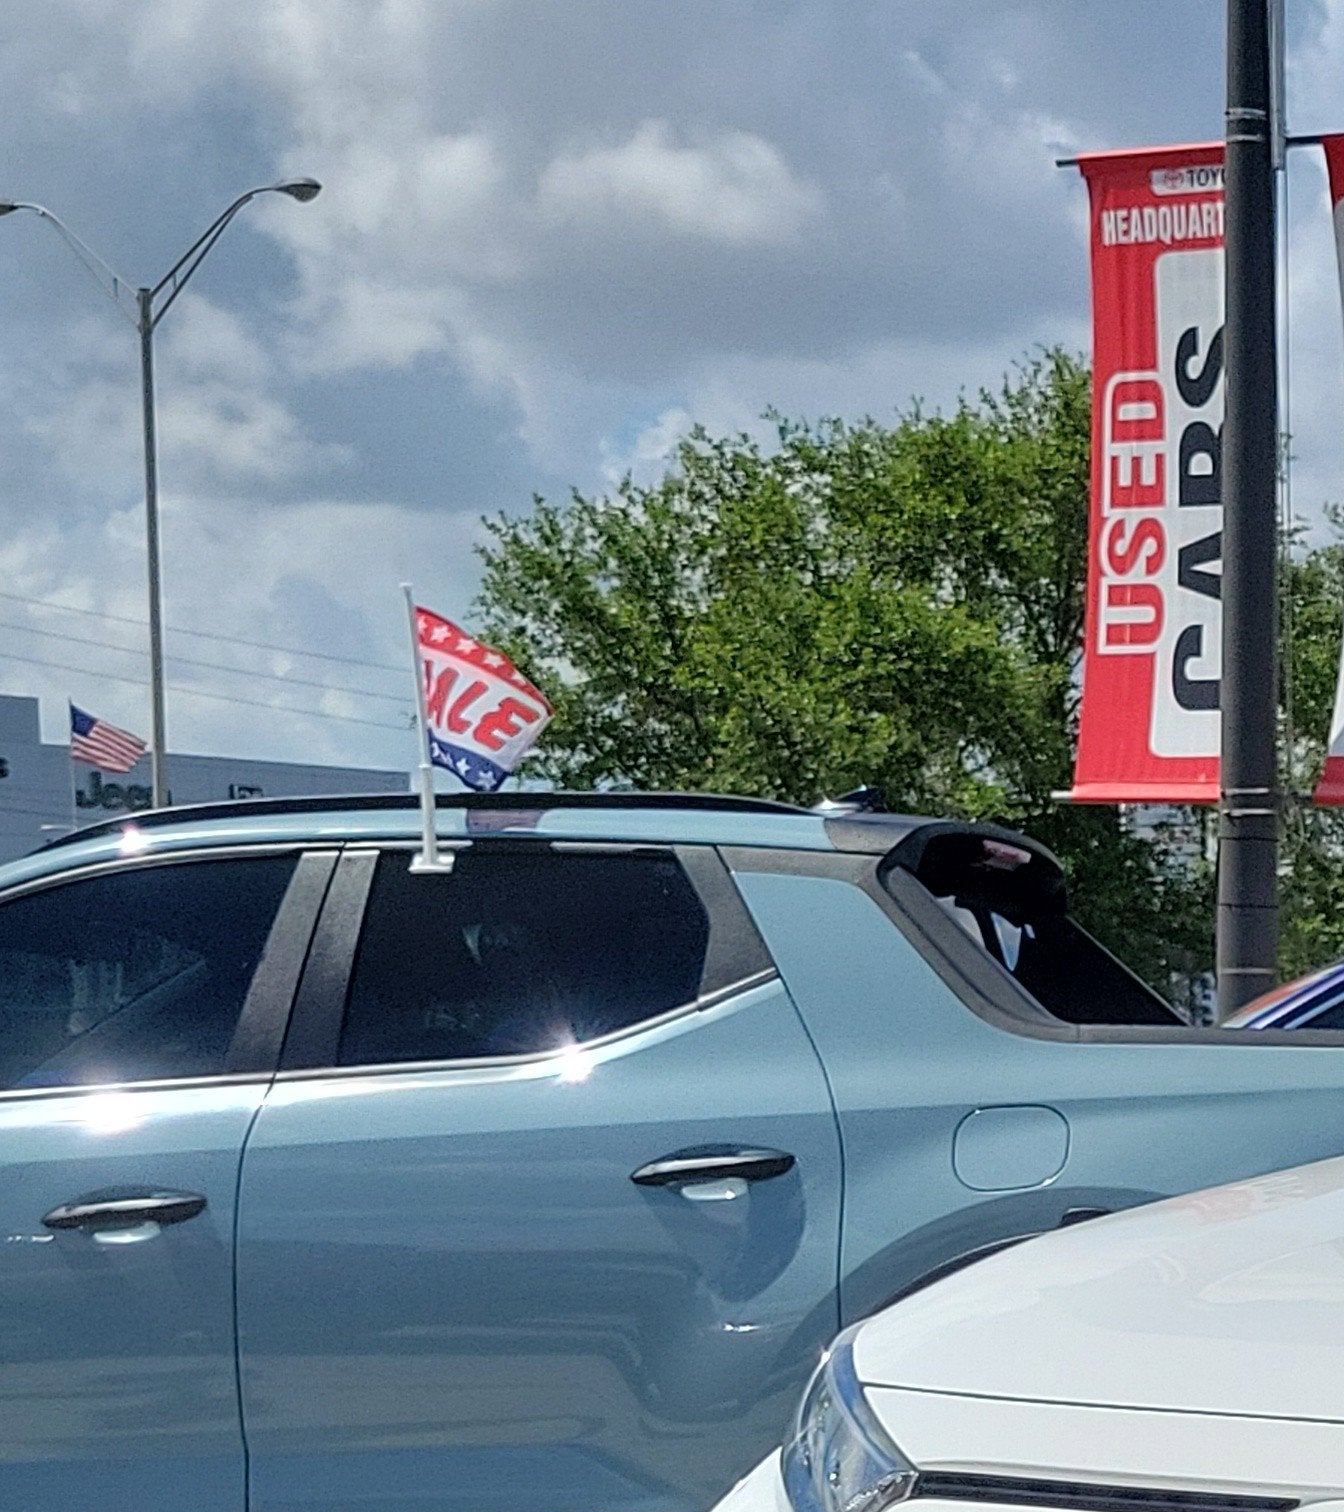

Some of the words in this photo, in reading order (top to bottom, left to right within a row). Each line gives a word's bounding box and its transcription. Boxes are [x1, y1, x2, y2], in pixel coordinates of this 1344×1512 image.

[1188, 168, 1226, 188] TOY
[1102, 202, 1225, 246] HEADQUART
[1103, 376, 1167, 648] USED
[424, 660, 540, 752] ALE
[76, 771, 173, 811] Jee
